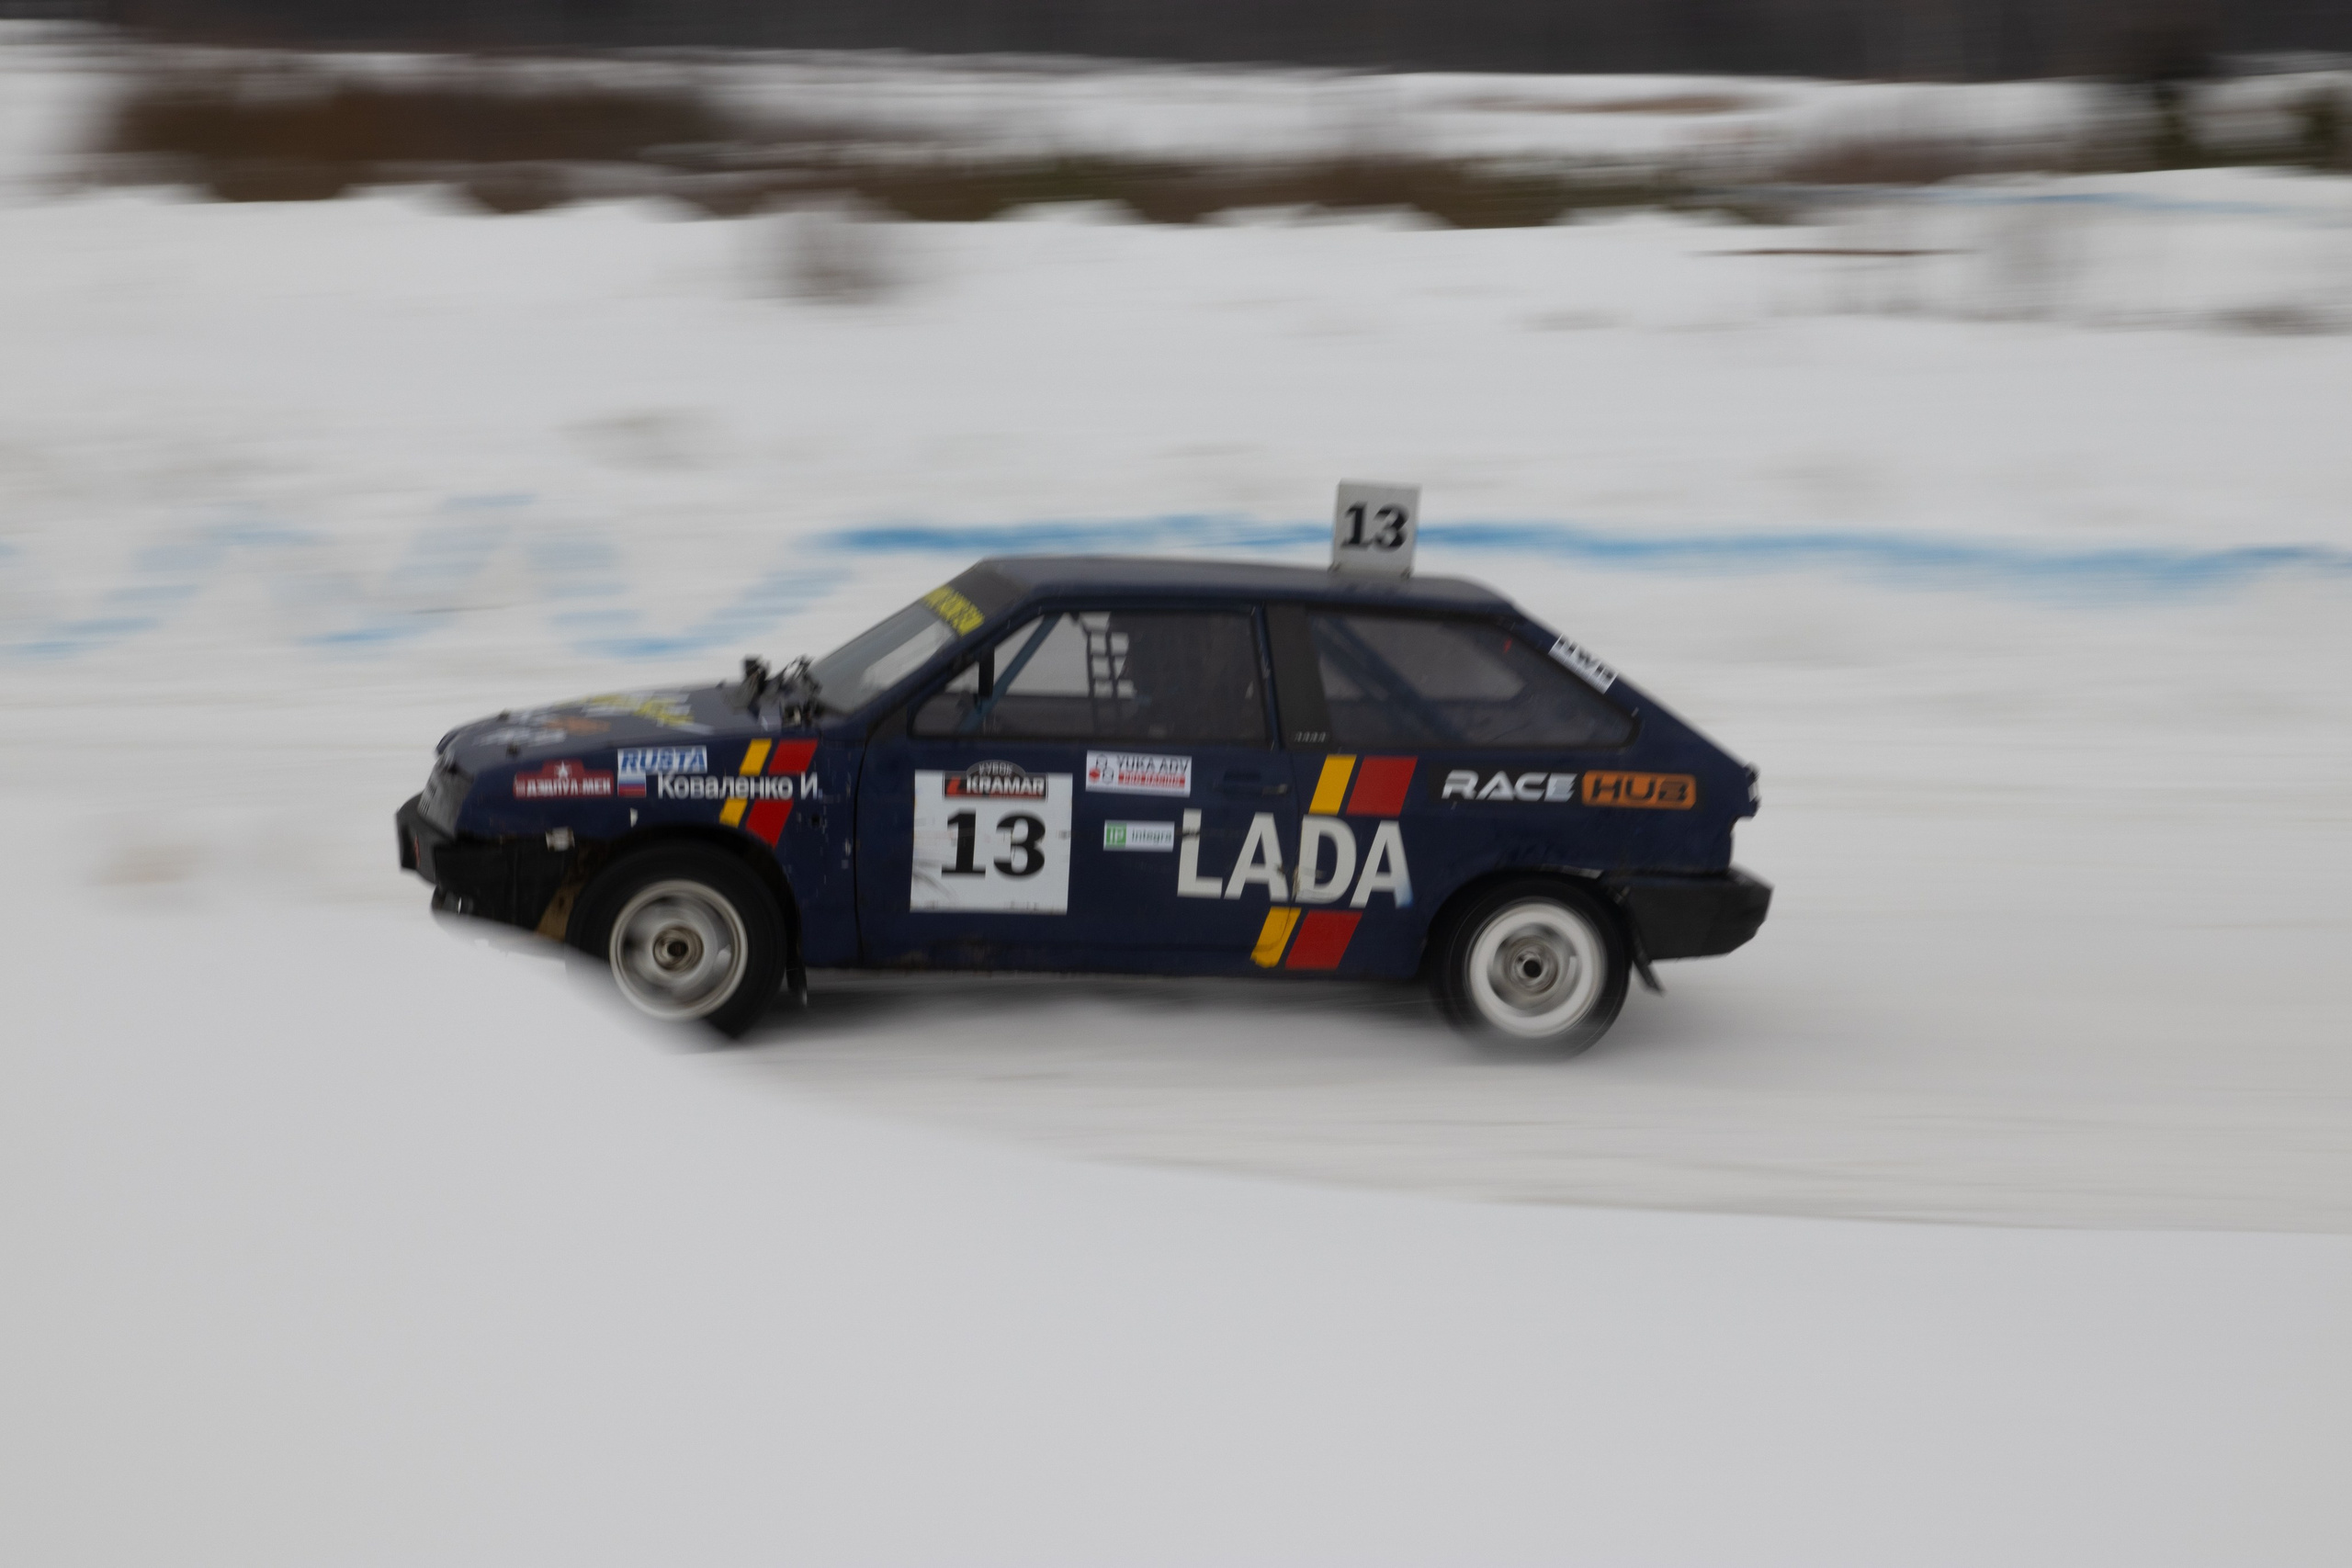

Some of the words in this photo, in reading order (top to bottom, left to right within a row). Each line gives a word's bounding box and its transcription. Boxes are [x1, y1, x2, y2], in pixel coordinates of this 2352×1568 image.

[1340, 501, 1409, 550] 13
[658, 771, 793, 799] Коваленко
[800, 772, 823, 800] И.
[966, 774, 1045, 795] KRAMAR
[1442, 770, 1577, 802] RACE
[1589, 774, 1689, 803] HUB
[941, 808, 1046, 879] 13
[1177, 807, 1415, 909] LADA
